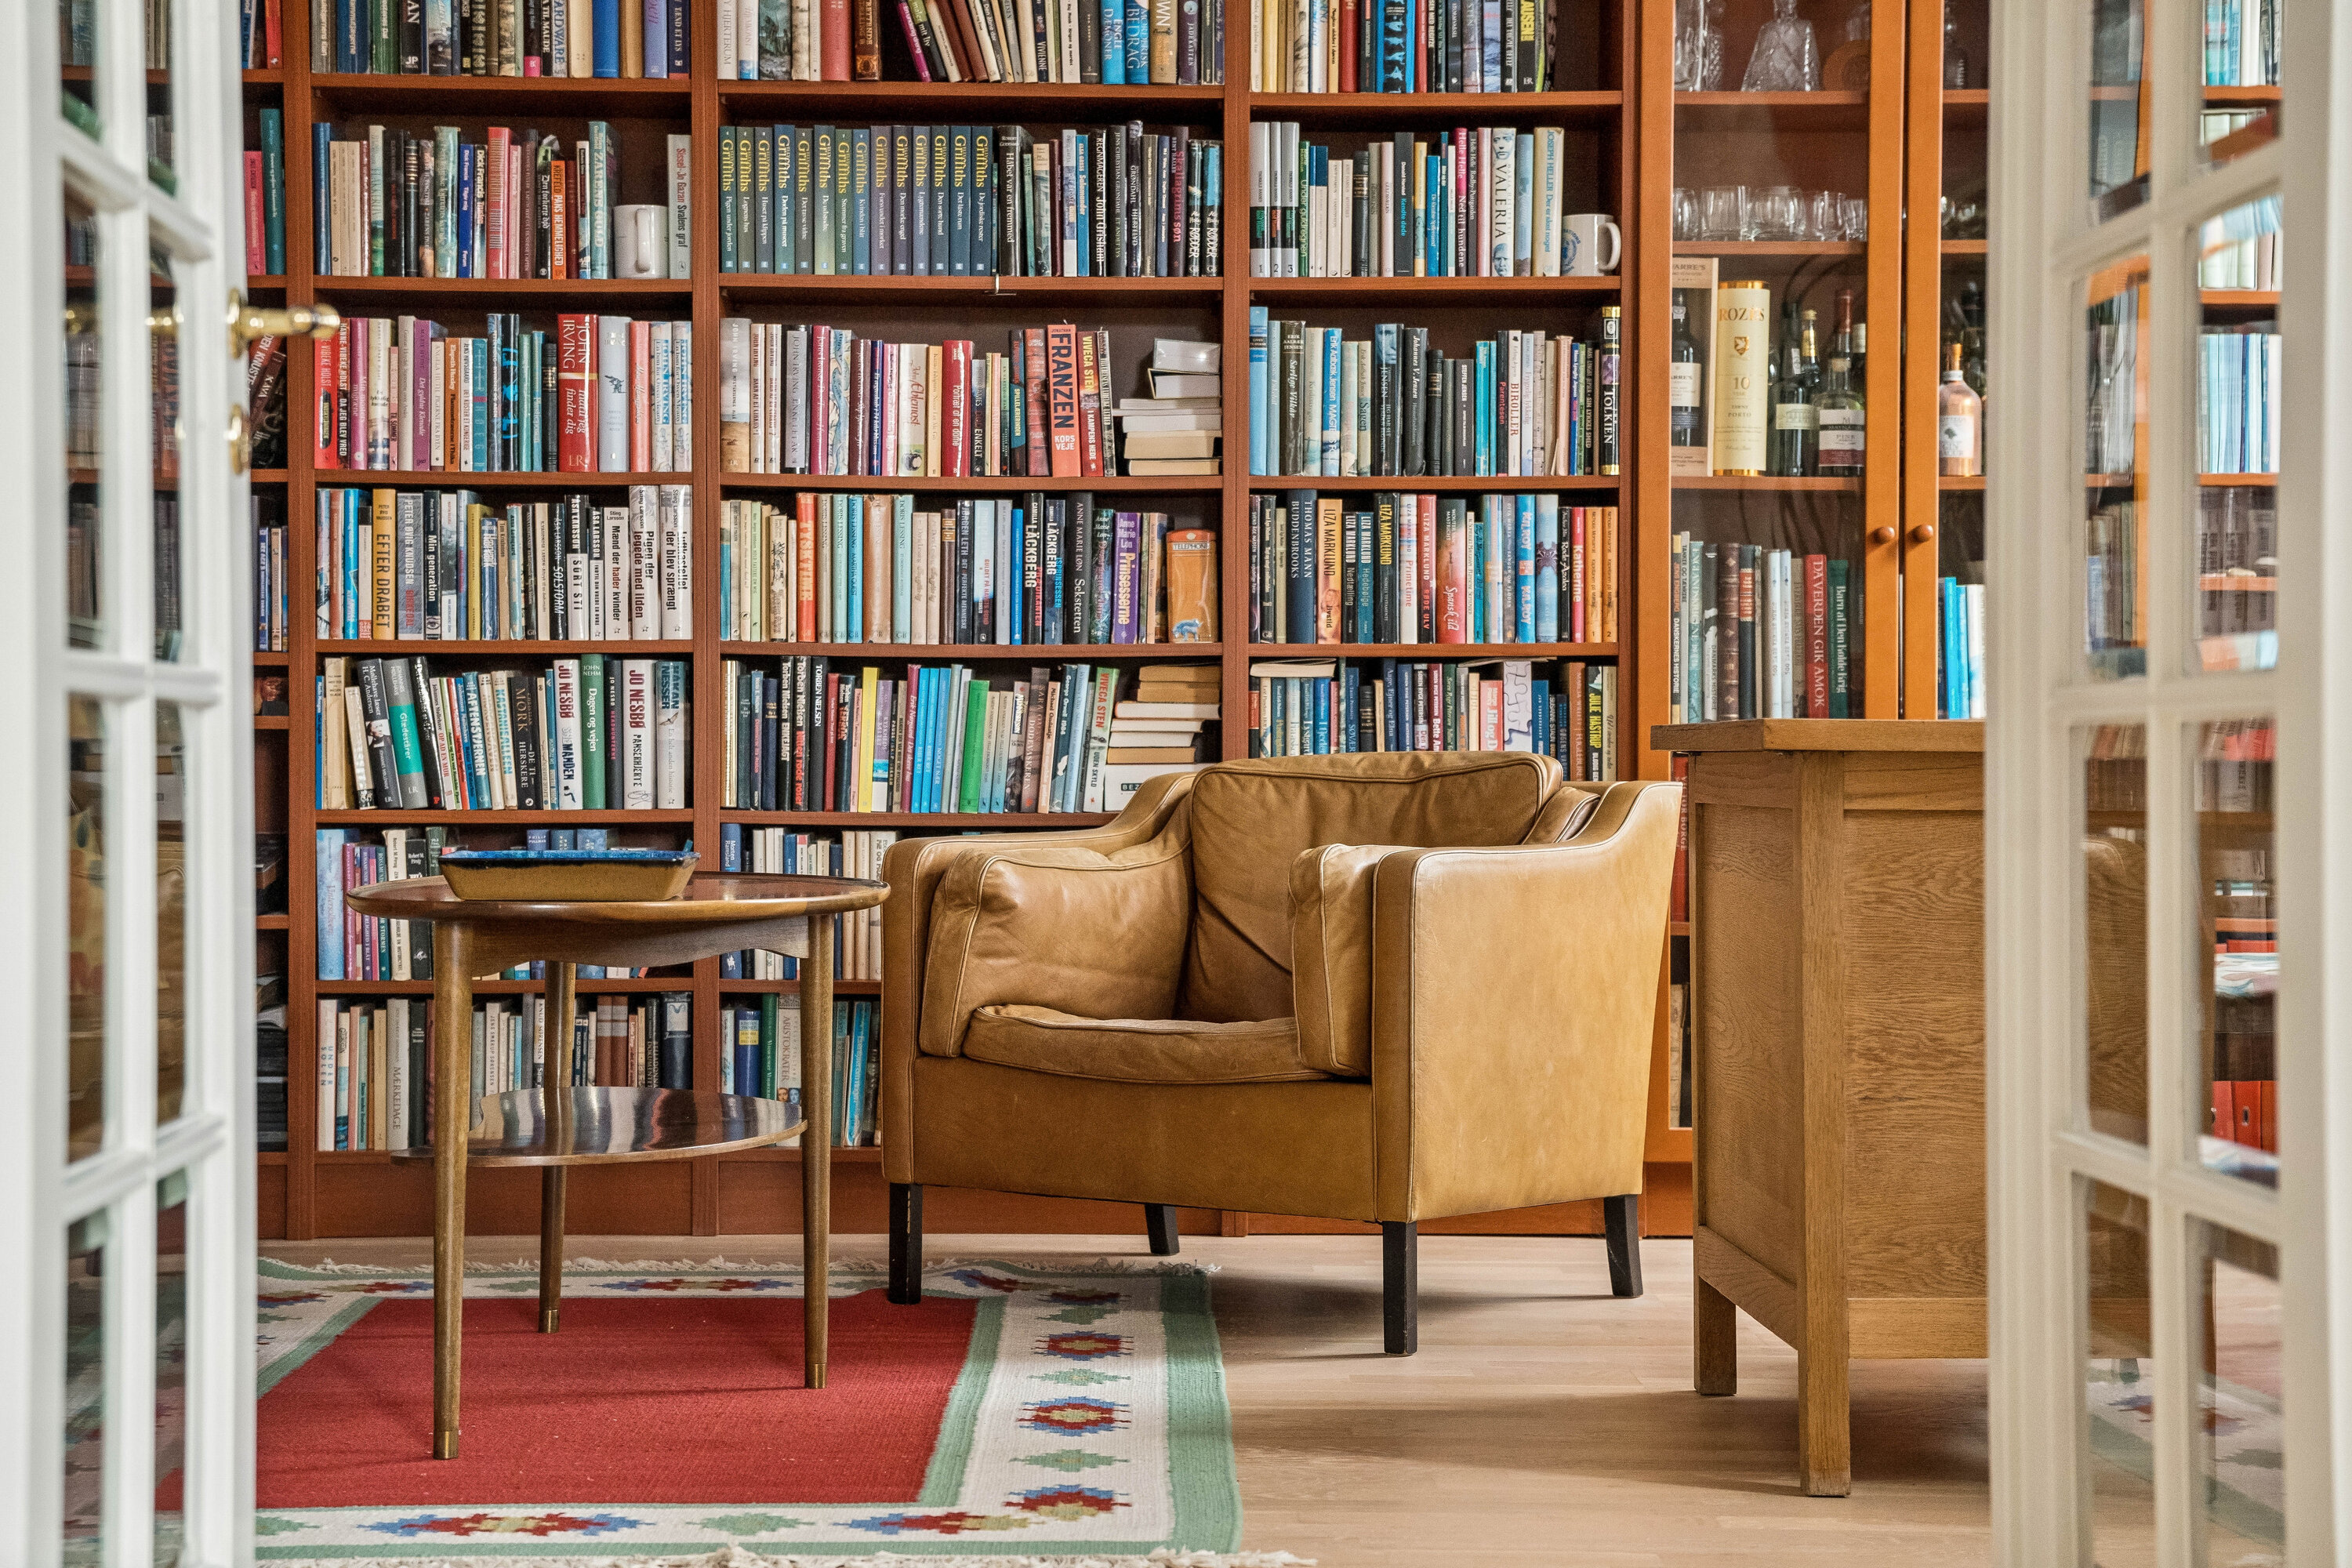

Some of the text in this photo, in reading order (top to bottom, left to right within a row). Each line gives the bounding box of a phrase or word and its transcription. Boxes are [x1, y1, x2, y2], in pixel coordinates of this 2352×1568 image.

[593, 152, 603, 207] ZARENS
[723, 139, 734, 191] Griffiths
[676, 182, 686, 202] Gazan
[1006, 194, 1013, 205] en
[1494, 164, 1506, 238] VALERIA
[677, 205, 687, 230] Svalens
[1173, 222, 1182, 242] søn
[563, 320, 575, 368] IRVING
[1083, 336, 1094, 392] VIVECA STEN
[339, 398, 347, 407] DA
[1051, 333, 1074, 428] FRANZEN
[1733, 376, 1751, 390] 10
[565, 388, 576, 434] finder dig
[1358, 402, 1369, 431] Sagen
[1511, 383, 1519, 436] BIROLLER
[1604, 389, 1613, 444] TOLKIEN
[405, 499, 414, 524] PETER
[405, 527, 414, 544] ØVIG
[1304, 501, 1312, 543] THOMAS
[1345, 515, 1356, 528] LIZA
[1025, 525, 1040, 587] LÄCKBERG
[1291, 501, 1300, 578] BUDDENBROOKS
[1323, 509, 1335, 576] LIZA MARKLUND
[1345, 531, 1356, 562] MARKLUND
[376, 534, 390, 629] EFTER DRABET
[405, 547, 414, 584] KNUDSEN
[426, 535, 437, 601] Min generation
[633, 532, 644, 618] legede med ilden
[645, 563, 654, 579] der
[1118, 553, 1135, 624] Prinsesserne
[1573, 545, 1582, 601] Katherine
[554, 567, 564, 614] SOLSTORM
[1074, 579, 1085, 633] Sekstetten
[1813, 561, 1824, 708] DA VERDEN GIK AMOK
[629, 670, 644, 685] JO
[662, 666, 670, 710] NESSER
[1095, 673, 1109, 728] VIVECA STEN
[586, 688, 597, 751] Dagen og vejen
[629, 689, 645, 728] NESBØ
[1589, 694, 1602, 748] JULIE HASTRUP
[400, 713, 412, 760] Glædestårer
[467, 692, 485, 775] AFTENSTJERNEN
[519, 742, 528, 788] HERSKERE
